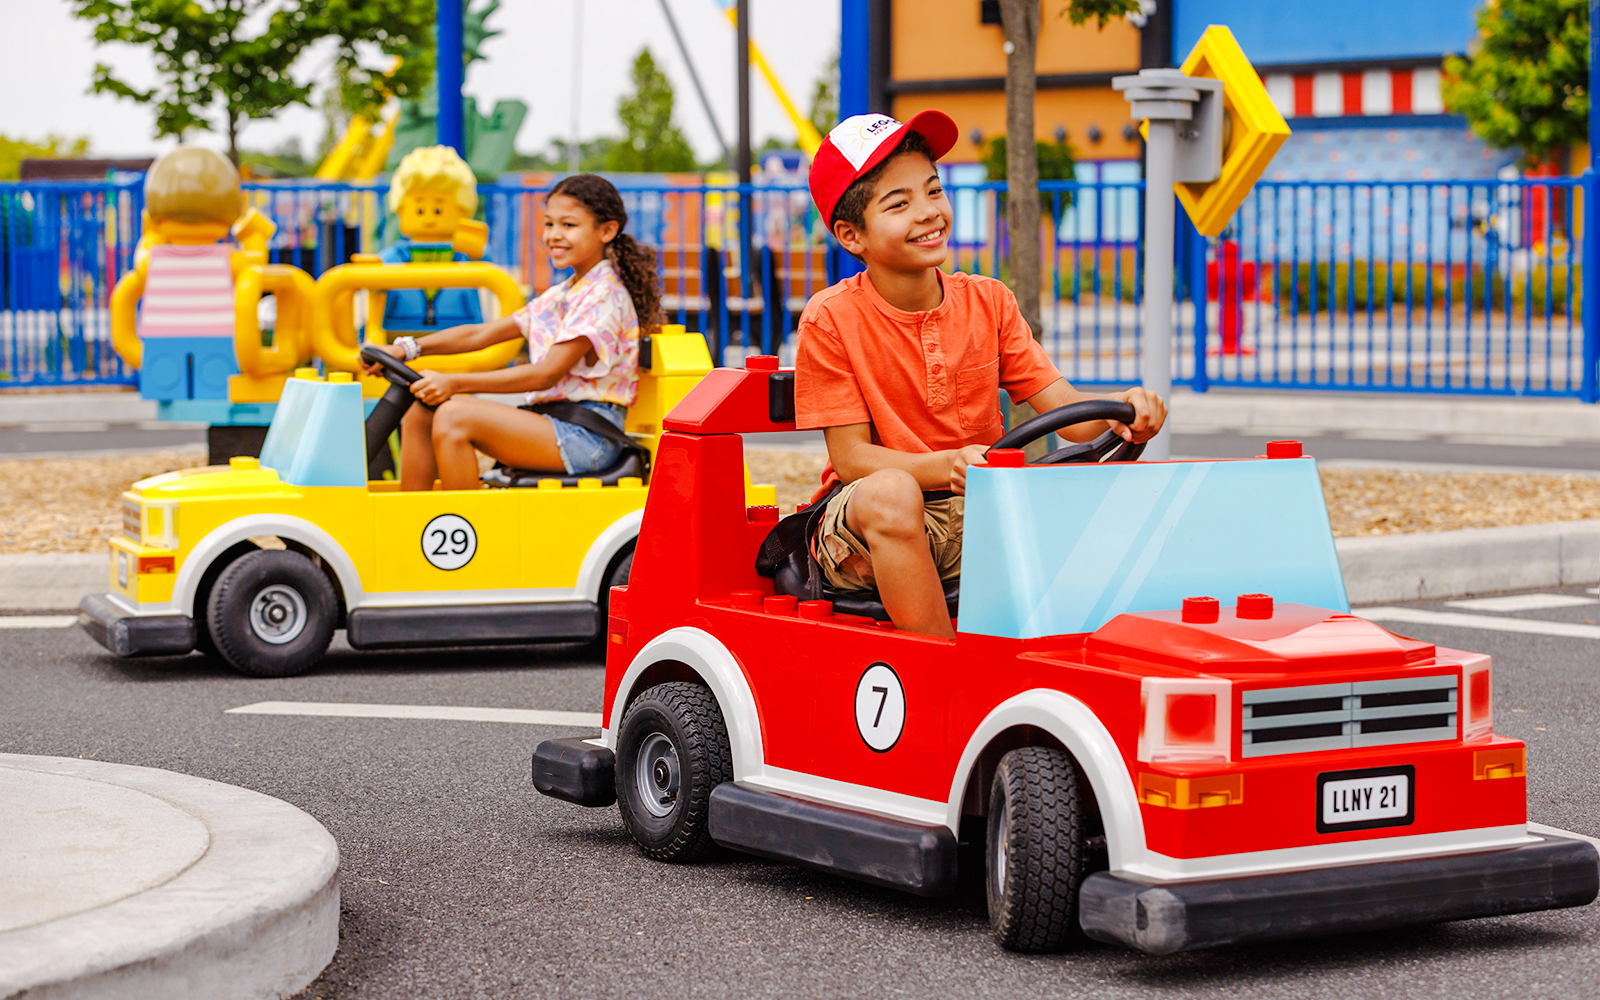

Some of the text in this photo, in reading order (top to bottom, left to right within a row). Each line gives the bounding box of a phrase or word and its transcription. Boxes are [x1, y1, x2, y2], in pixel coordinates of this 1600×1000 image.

[431, 529, 468, 555] 29
[872, 686, 888, 728] 7
[1333, 785, 1397, 813] LLNY 21
